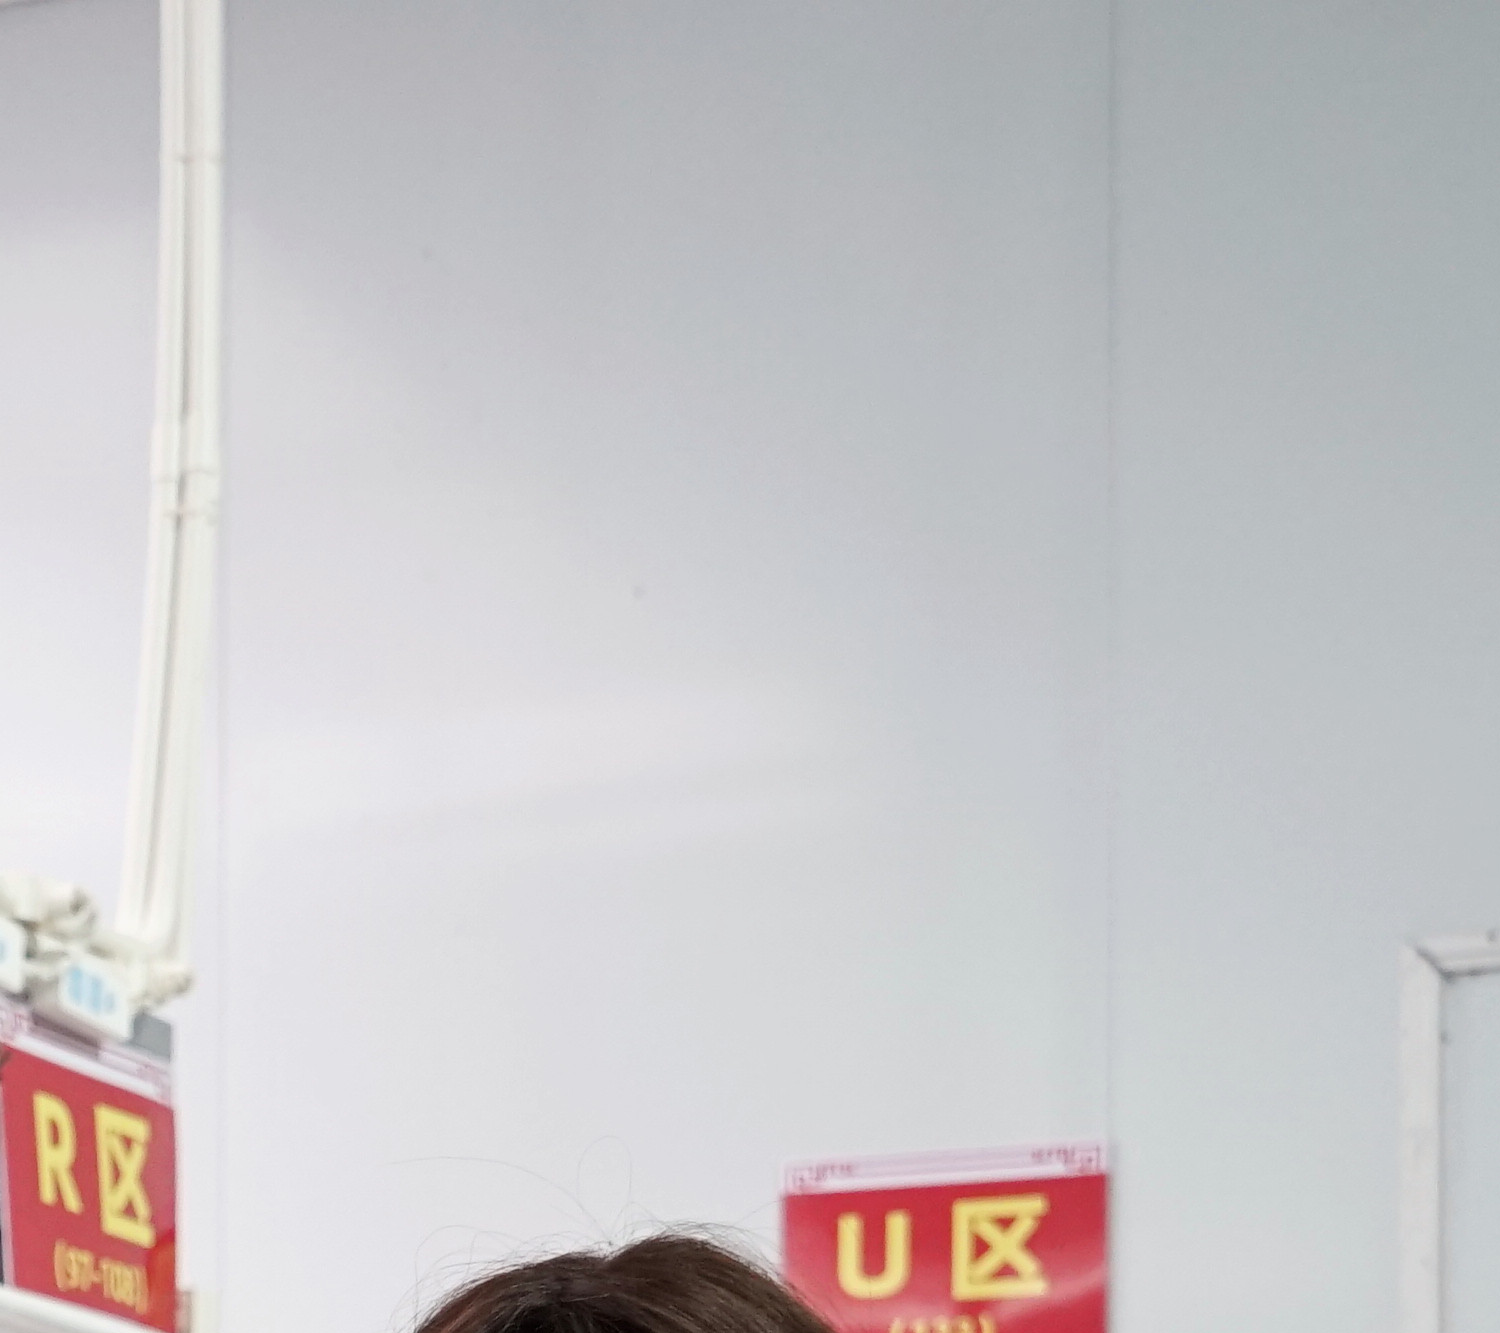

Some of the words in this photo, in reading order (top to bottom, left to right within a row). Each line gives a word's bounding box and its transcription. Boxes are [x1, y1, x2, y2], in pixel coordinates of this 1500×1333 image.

[32, 1088, 84, 1214] R
[93, 1103, 157, 1249] 区
[837, 1209, 913, 1300] U
[952, 1192, 1050, 1303] 区
